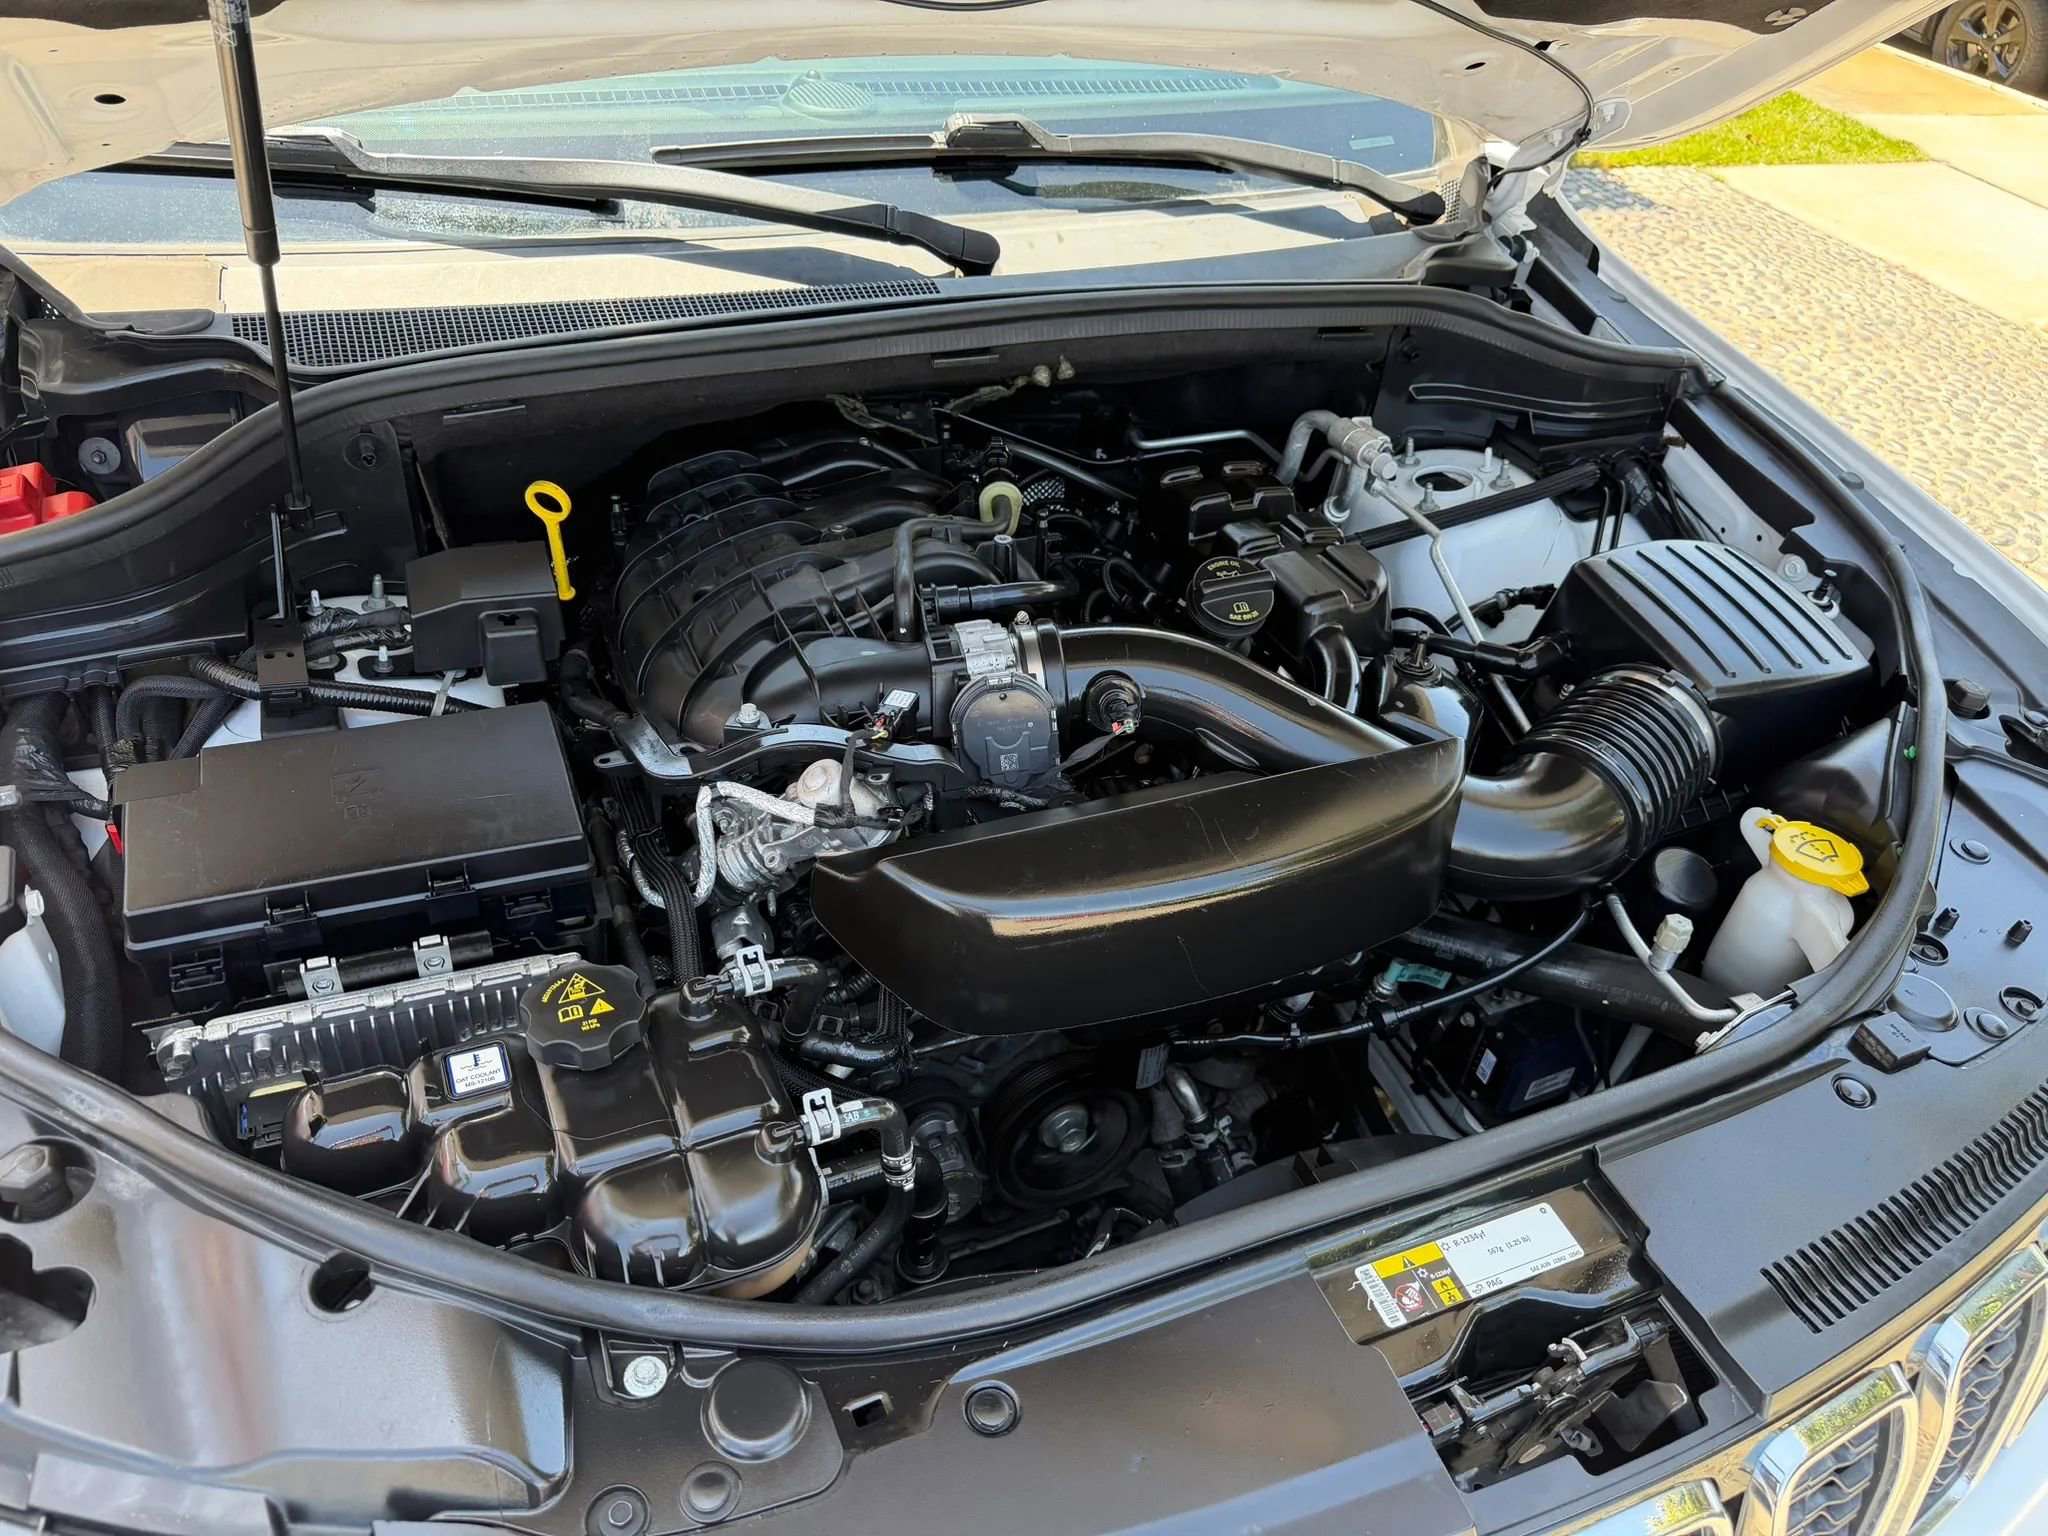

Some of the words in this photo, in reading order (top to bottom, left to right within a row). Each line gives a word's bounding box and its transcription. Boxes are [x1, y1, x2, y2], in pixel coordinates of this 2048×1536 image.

[470, 1068, 501, 1080] COOLANT
[1453, 1230, 1486, 1247] R-1234yf
[1487, 1246, 1504, 1256] 567g
[1505, 1238, 1521, 1250] (1.25
[1521, 1235, 1531, 1245] lb)
[1486, 1278, 1503, 1289] PAG
